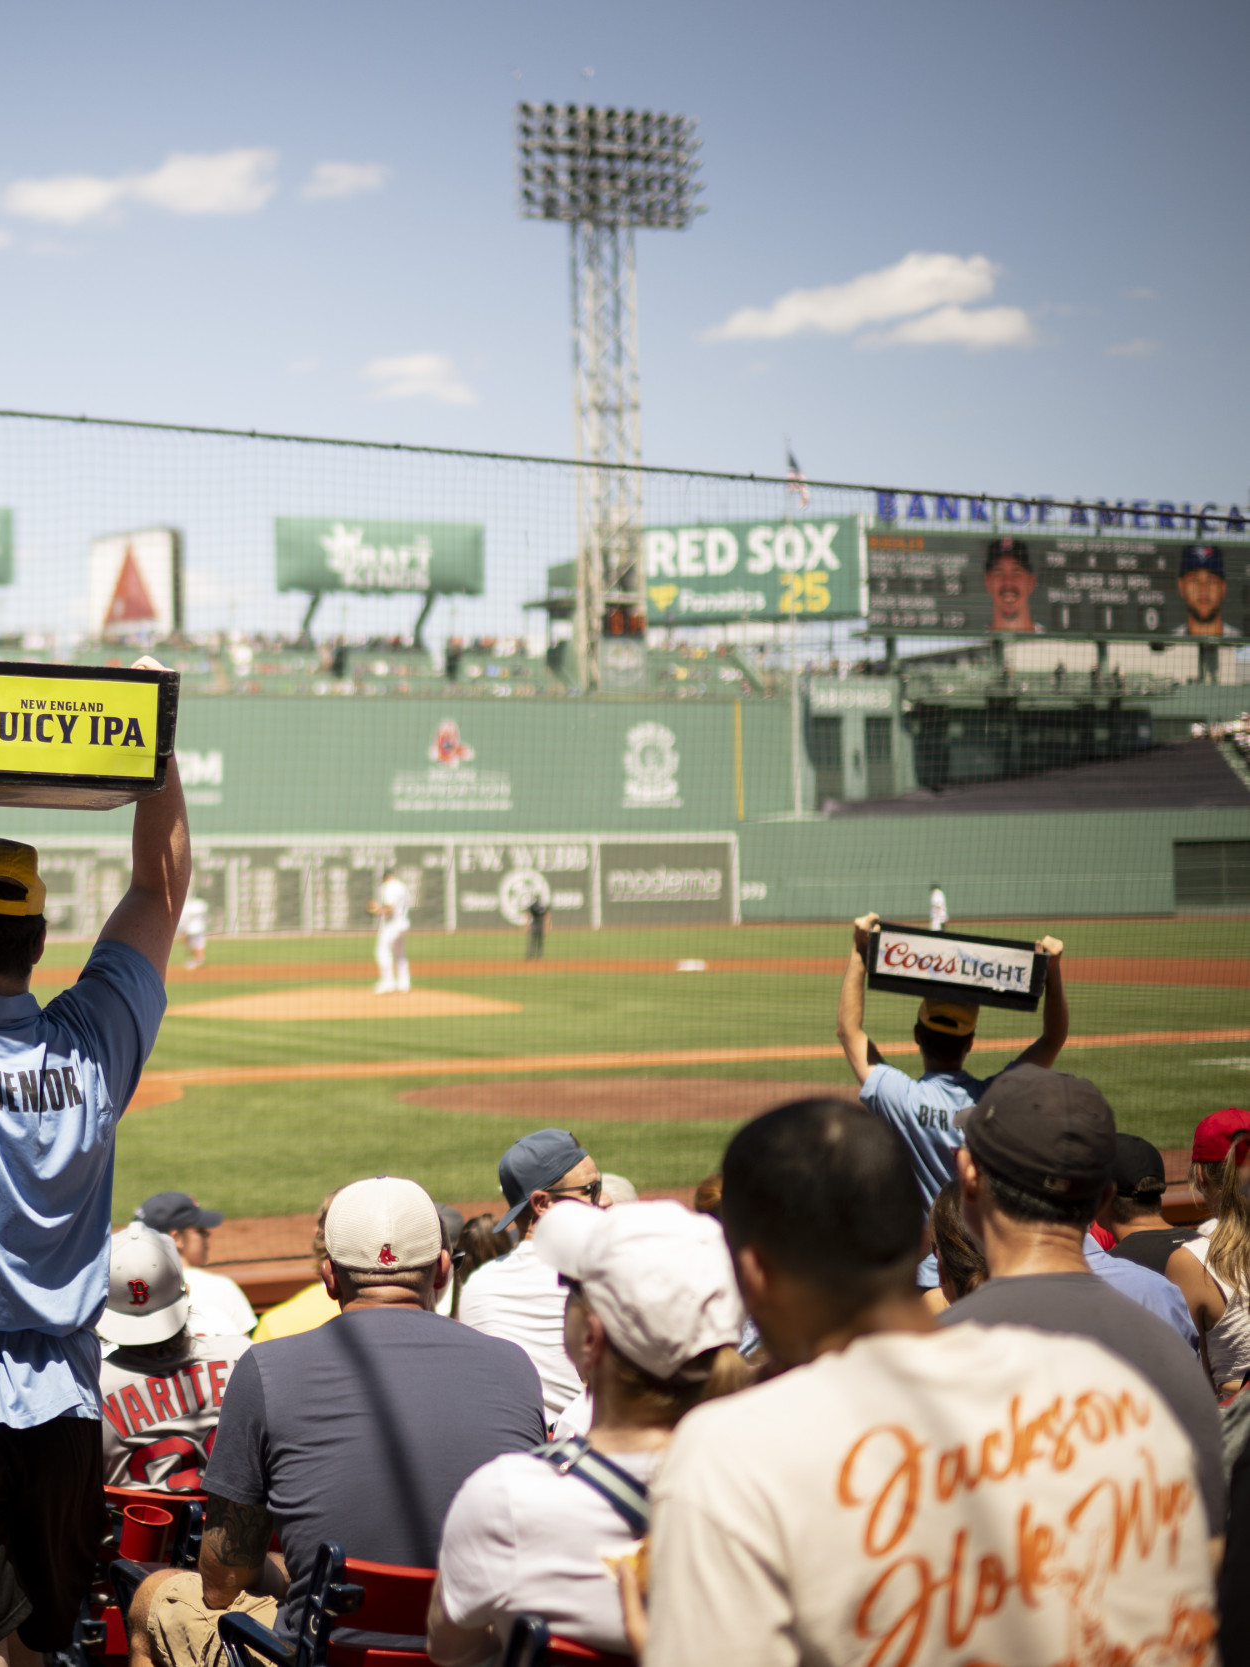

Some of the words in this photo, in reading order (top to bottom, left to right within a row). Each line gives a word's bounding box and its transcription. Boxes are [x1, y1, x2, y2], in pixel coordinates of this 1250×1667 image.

[878, 487, 989, 522] BANK
[1005, 494, 1053, 524] OF
[1070, 497, 1246, 532] AMERICA
[644, 528, 739, 577] RED
[747, 523, 840, 574] SOX
[679, 587, 766, 613] Fanatics
[779, 570, 831, 614] 25
[21, 699, 46, 710] NEW
[50, 700, 104, 713] ENGLAND
[88, 715, 146, 748] IPA
[884, 941, 956, 974] Coors
[960, 959, 1026, 983] LIGHT
[128, 1279, 149, 1306] B
[103, 1360, 238, 1438] VARITE
[837, 1390, 1151, 1558] Jackson
